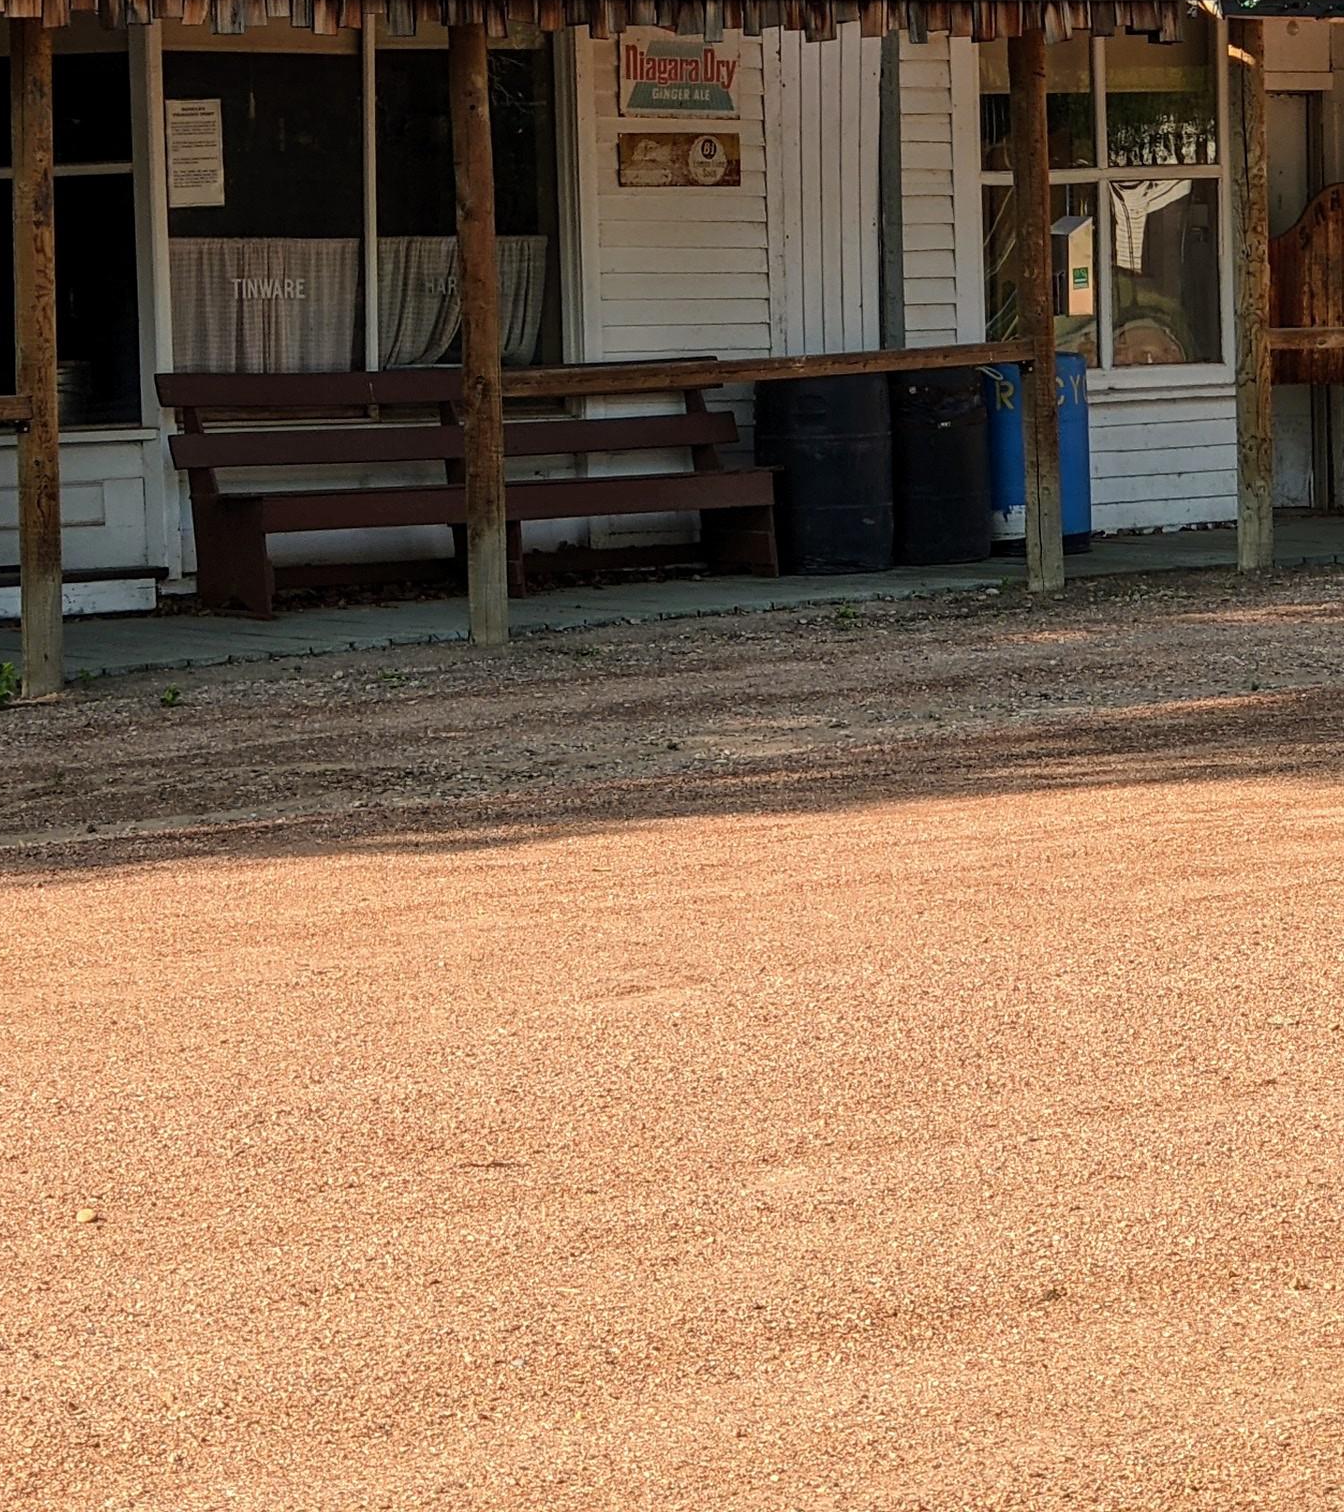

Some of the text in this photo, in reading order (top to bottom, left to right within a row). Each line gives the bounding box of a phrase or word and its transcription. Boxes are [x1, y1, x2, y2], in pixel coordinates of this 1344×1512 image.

[624, 43, 737, 90] Niagara Dry
[651, 87, 710, 101] GINGER ALE
[231, 277, 307, 300] TINWARE
